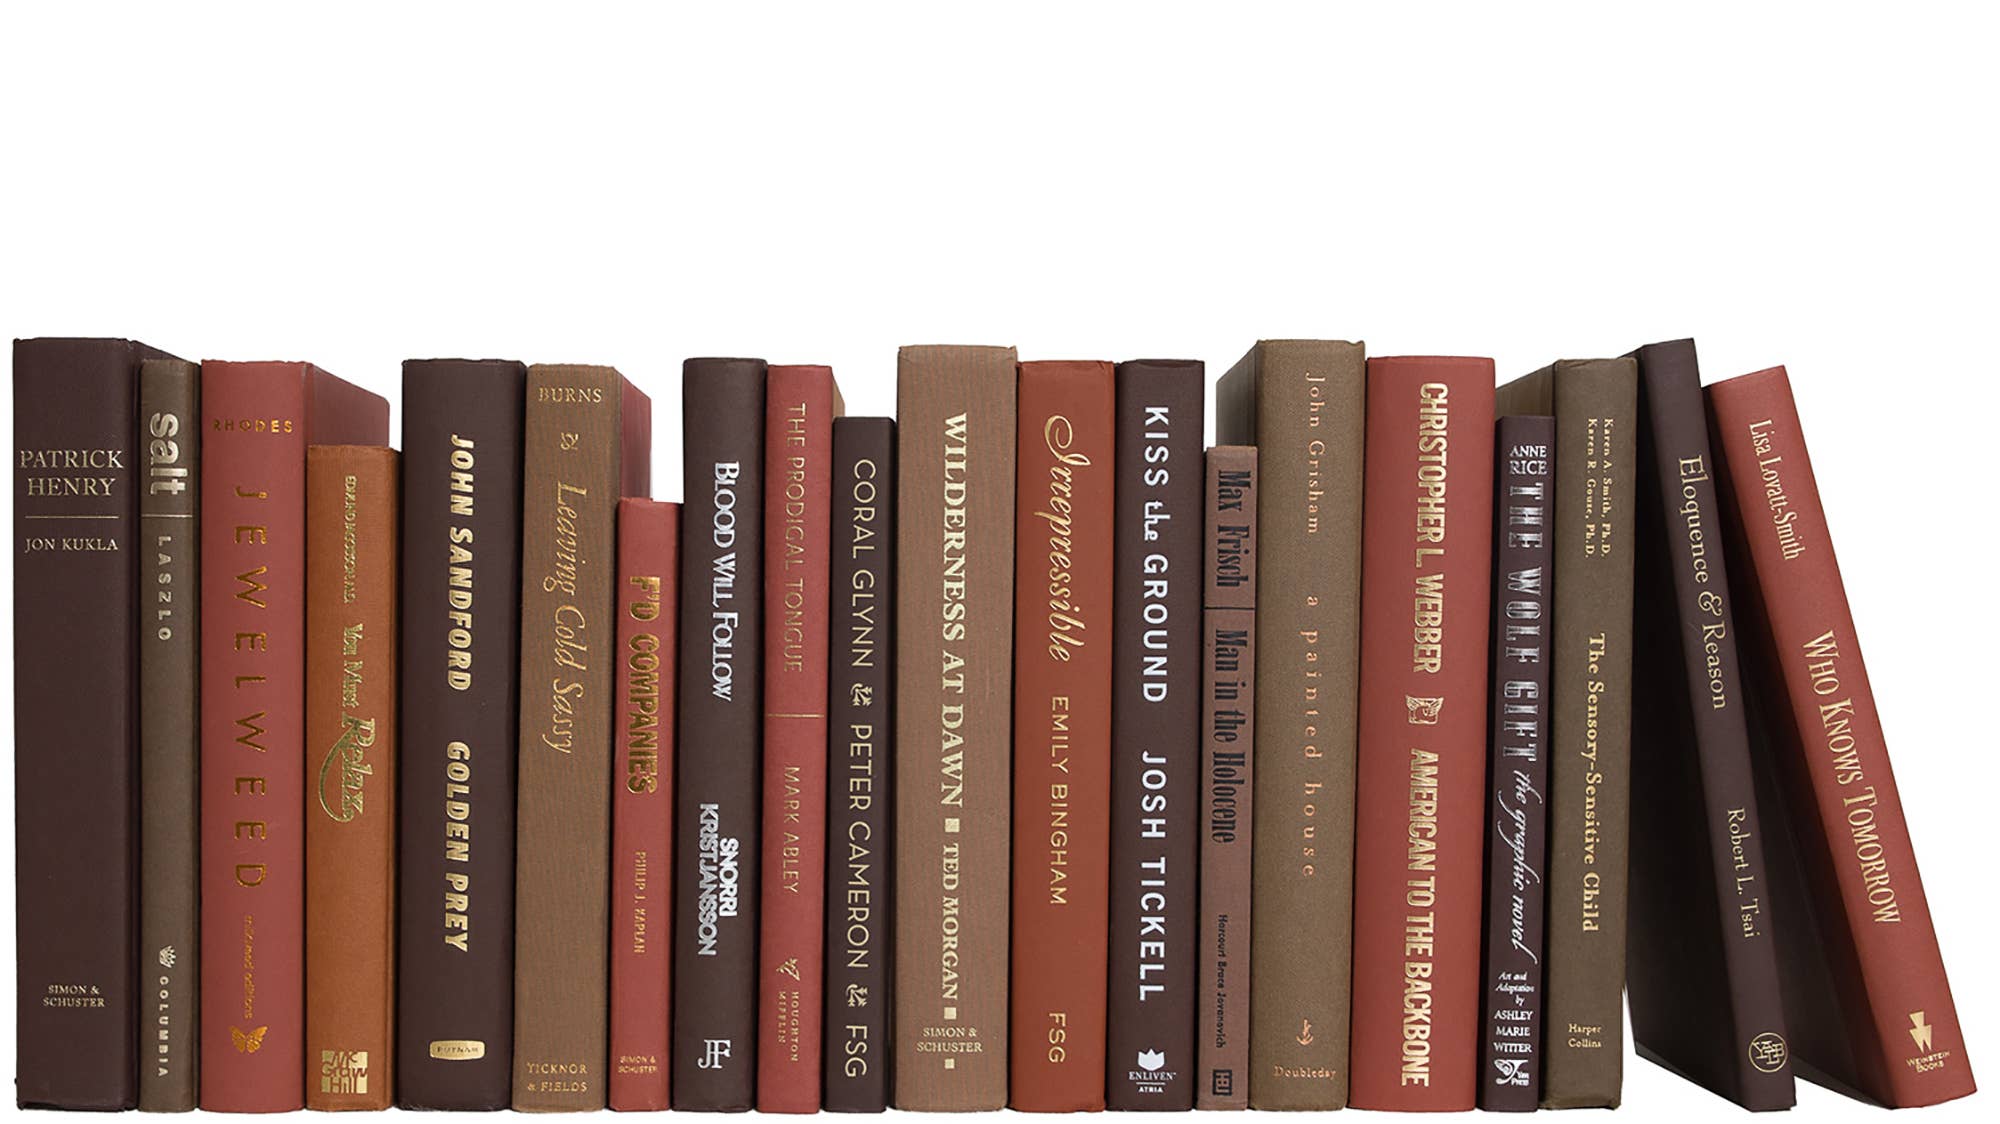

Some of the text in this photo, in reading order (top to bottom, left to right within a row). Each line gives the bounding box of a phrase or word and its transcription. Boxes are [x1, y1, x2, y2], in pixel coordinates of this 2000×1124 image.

[149, 411, 188, 495] salt
[213, 419, 293, 434] RHODES
[538, 387, 602, 403] BURNS
[1306, 373, 1325, 534] John Grisham
[1510, 445, 1547, 458] ANNE
[1587, 418, 1598, 456] Karen
[20, 449, 124, 497] PATRICK HENRY
[1510, 460, 1547, 475] RICE
[1587, 460, 1597, 473] R.
[1601, 418, 1613, 558] Karen A. Smith, Ph.D.
[1749, 419, 1806, 561] Lisa Lovatt-Smith
[25, 538, 118, 553] JON KUKLA
[447, 434, 475, 691] JOHN SANDFORD
[712, 461, 740, 701] BLOOD WILL FOLLOW
[784, 403, 806, 672] THE PRODIGAL TONGUE
[851, 459, 876, 667] CORAL GLYNN
[1033, 415, 1092, 662] Irrepressible
[1142, 406, 1170, 702] KISS the GROUND
[1216, 470, 1250, 587] Max Frisch
[1413, 383, 1448, 674] CHRISTOPHER L. WEBBER
[1585, 523, 1595, 558] Ph.D.
[1678, 455, 1727, 710] Eloquence & Reason
[158, 536, 171, 641] LASZLO
[542, 481, 588, 754] Leaving Cold Sassy
[941, 412, 967, 807] WILDERNESS AT DAWN
[1503, 482, 1544, 762] THE WOLF GIFT
[234, 486, 267, 888] JEWELWEED
[319, 623, 376, 823] You Must Relax
[626, 576, 661, 794] F'D COMPANIES
[1212, 630, 1247, 844] Man in the Holocene
[1300, 595, 1322, 876] a painted house
[783, 767, 800, 894] MARK ABLEY
[1049, 697, 1069, 905] EMILY BINGHAM
[1581, 633, 1606, 933] The Sensory-Sensitive Child
[1803, 630, 1901, 924] WHO KNOWS TOMORROW
[445, 741, 470, 952] GOLDEN PREY
[633, 850, 647, 953] PHILIP J. KAPLAN
[698, 803, 719, 955] KRISTJANSSON
[719, 838, 739, 917] SNORRI
[847, 724, 872, 968] PETER CAMERON
[1138, 750, 1166, 1001] JOSH TICKELL
[1496, 769, 1543, 964] the graphic novel
[1727, 807, 1761, 938] Robert L. Tsai
[942, 843, 960, 1000] TED MORGAN
[1401, 748, 1439, 1087] AMERICAN TO THE BACKBONE
[43, 997, 105, 1008] SCHUSTER
[48, 984, 100, 996] SIMON &
[158, 976, 170, 1077] COLUMBIA
[778, 991, 787, 1043] MIFFLIN
[790, 991, 800, 1061] HOUGHTON
[923, 1027, 977, 1038] SIMON &
[1048, 1012, 1066, 1063] FSG
[1215, 914, 1228, 1048] Harcourt Brace Jovanovich
[1494, 1010, 1533, 1020] ASHLEY
[1496, 1026, 1530, 1036] MARIE
[1568, 1023, 1602, 1035] Harper
[526, 1062, 588, 1075] TICKNOR
[527, 1081, 588, 1092] & FIELDS
[845, 1025, 867, 1077] FSG
[917, 1042, 983, 1053] SCHUSTER
[1273, 1065, 1336, 1079] Doubleday
[1493, 1042, 1532, 1052] WITTER
[1568, 1037, 1602, 1048] Collins
[1906, 1050, 1951, 1067] WEINSTEIN
[1915, 1061, 1945, 1073] BOOKS
